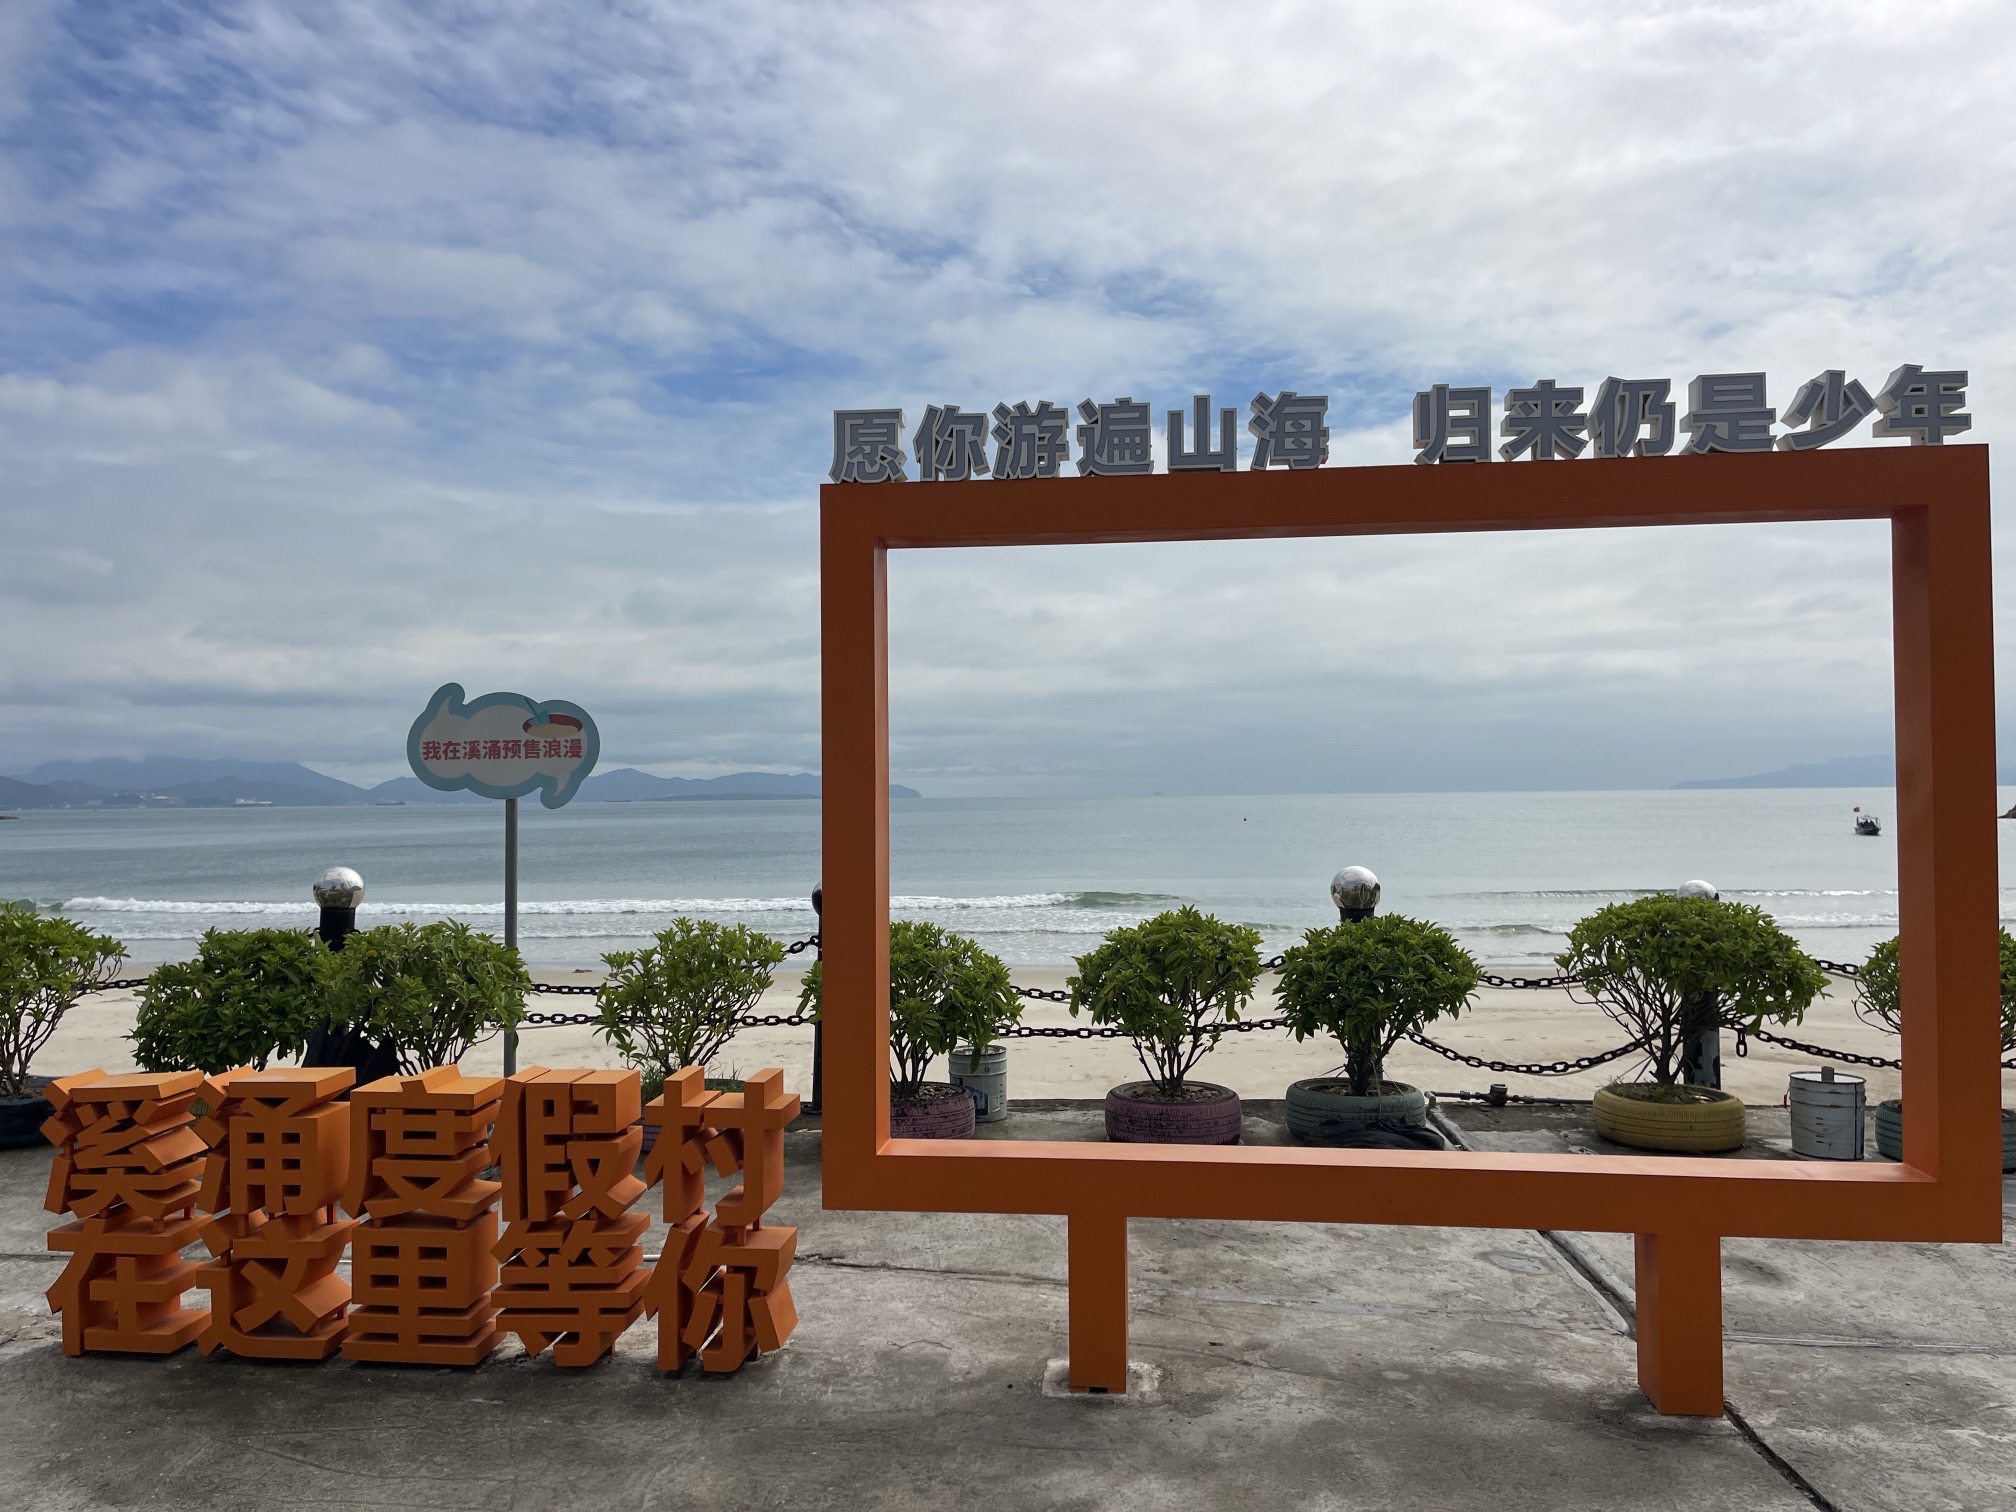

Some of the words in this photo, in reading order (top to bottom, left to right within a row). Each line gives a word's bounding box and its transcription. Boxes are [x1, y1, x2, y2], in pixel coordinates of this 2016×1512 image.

[829, 391, 1330, 484] 愿你游遍山海
[1413, 364, 1971, 465] 归来仍是少年
[422, 738, 583, 761] 我在溪涌预售浪漫
[40, 1065, 800, 1227] 溪涌度假村
[46, 1211, 798, 1372] 在这里等你
